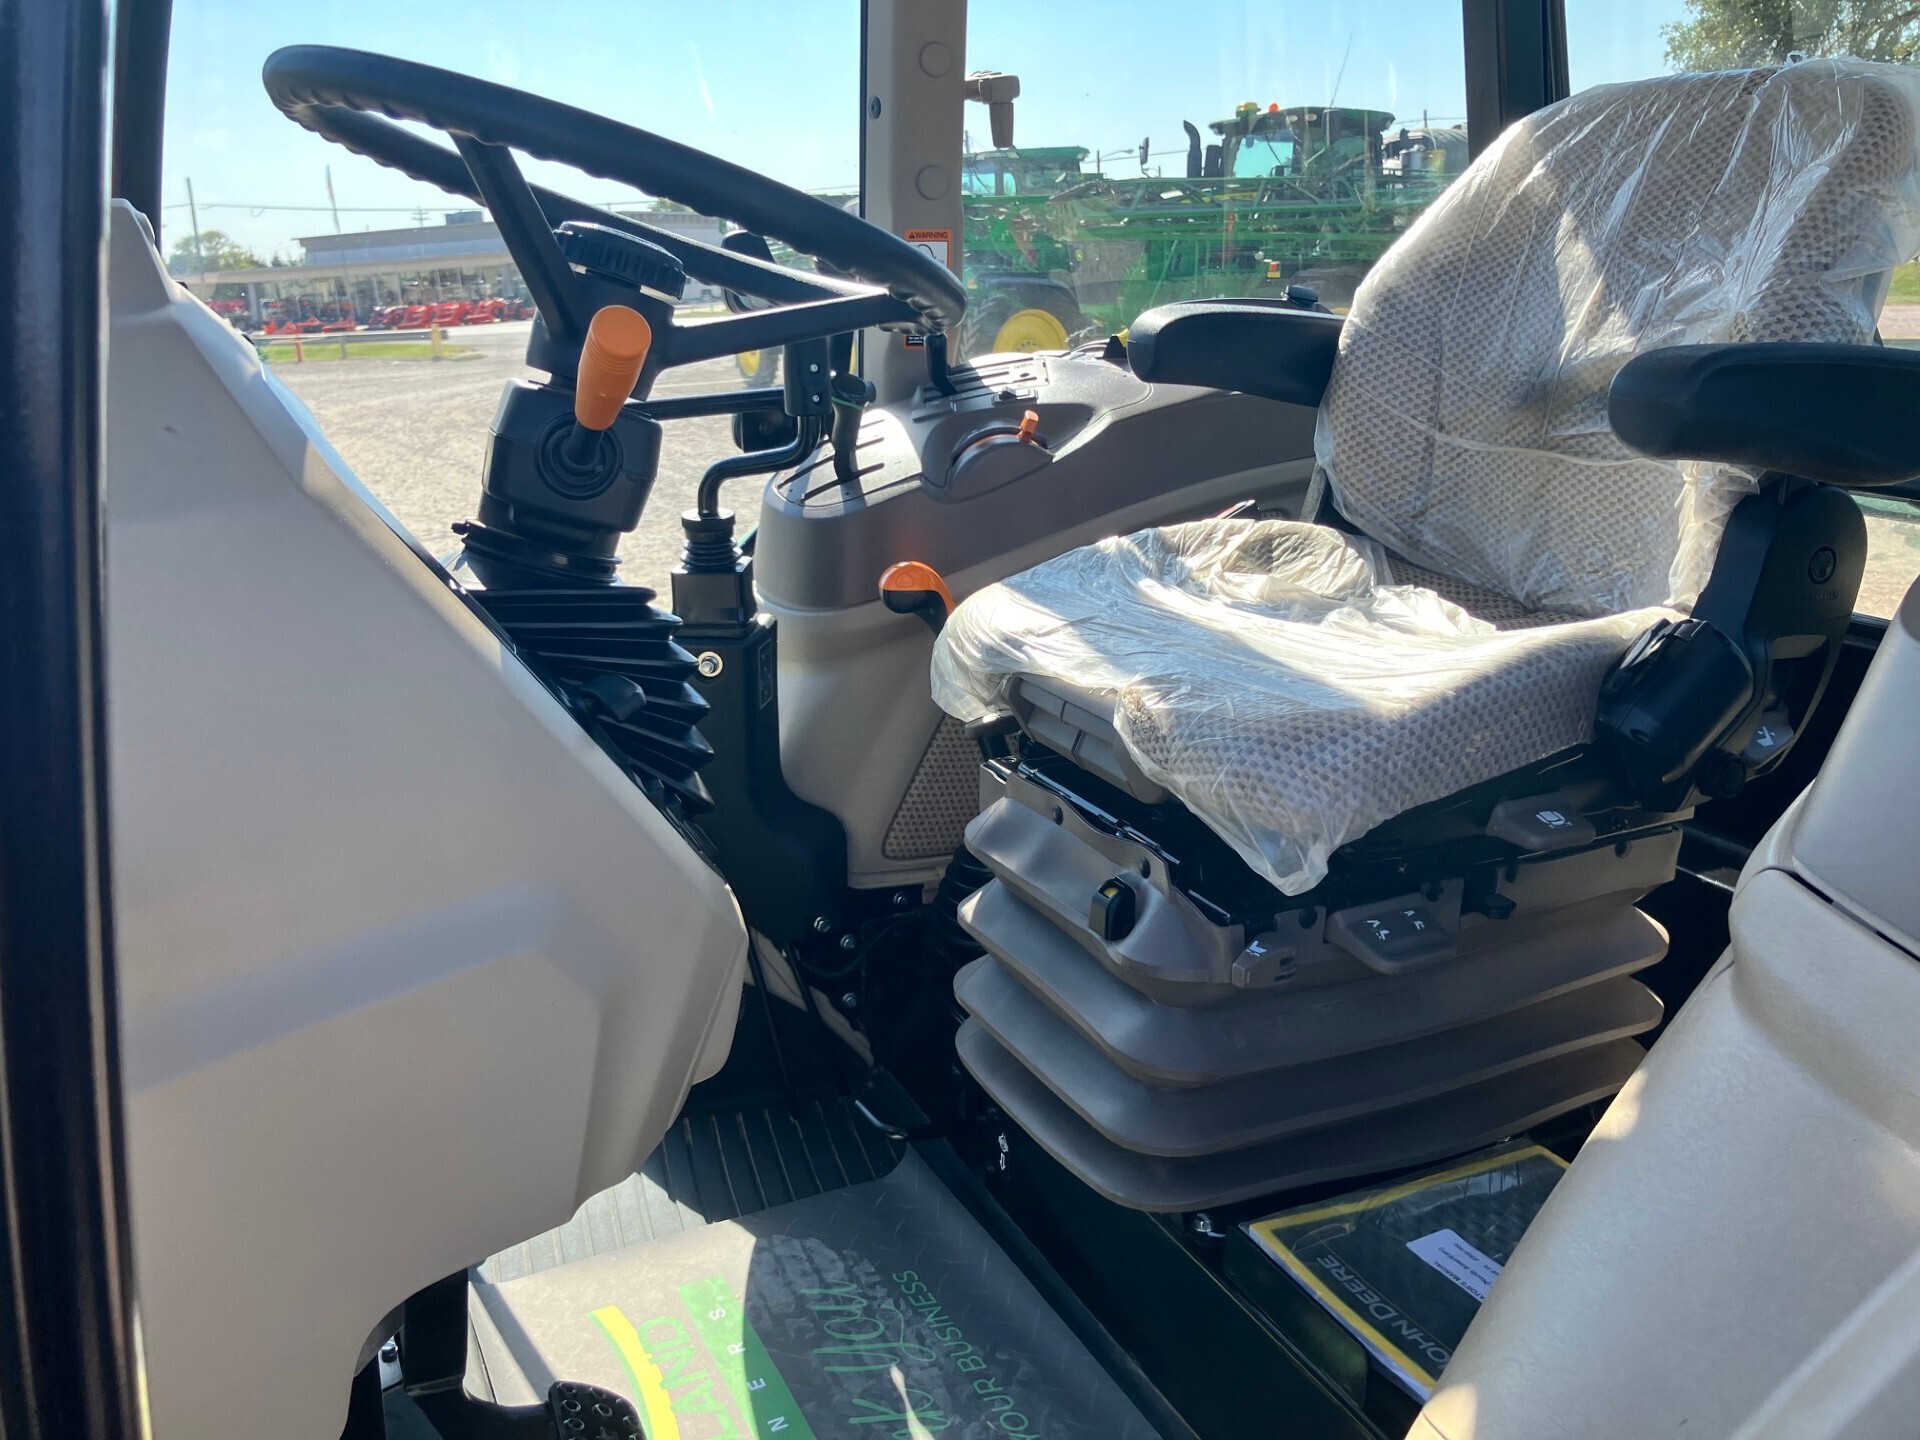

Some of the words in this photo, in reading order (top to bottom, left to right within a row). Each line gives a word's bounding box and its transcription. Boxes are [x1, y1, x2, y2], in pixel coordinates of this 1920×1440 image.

[914, 231, 948, 239] WARNING
[1316, 1254, 1399, 1320] DEERE
[1433, 1261, 1462, 1282] MANUAL
[892, 1270, 987, 1372] BUSINESS
